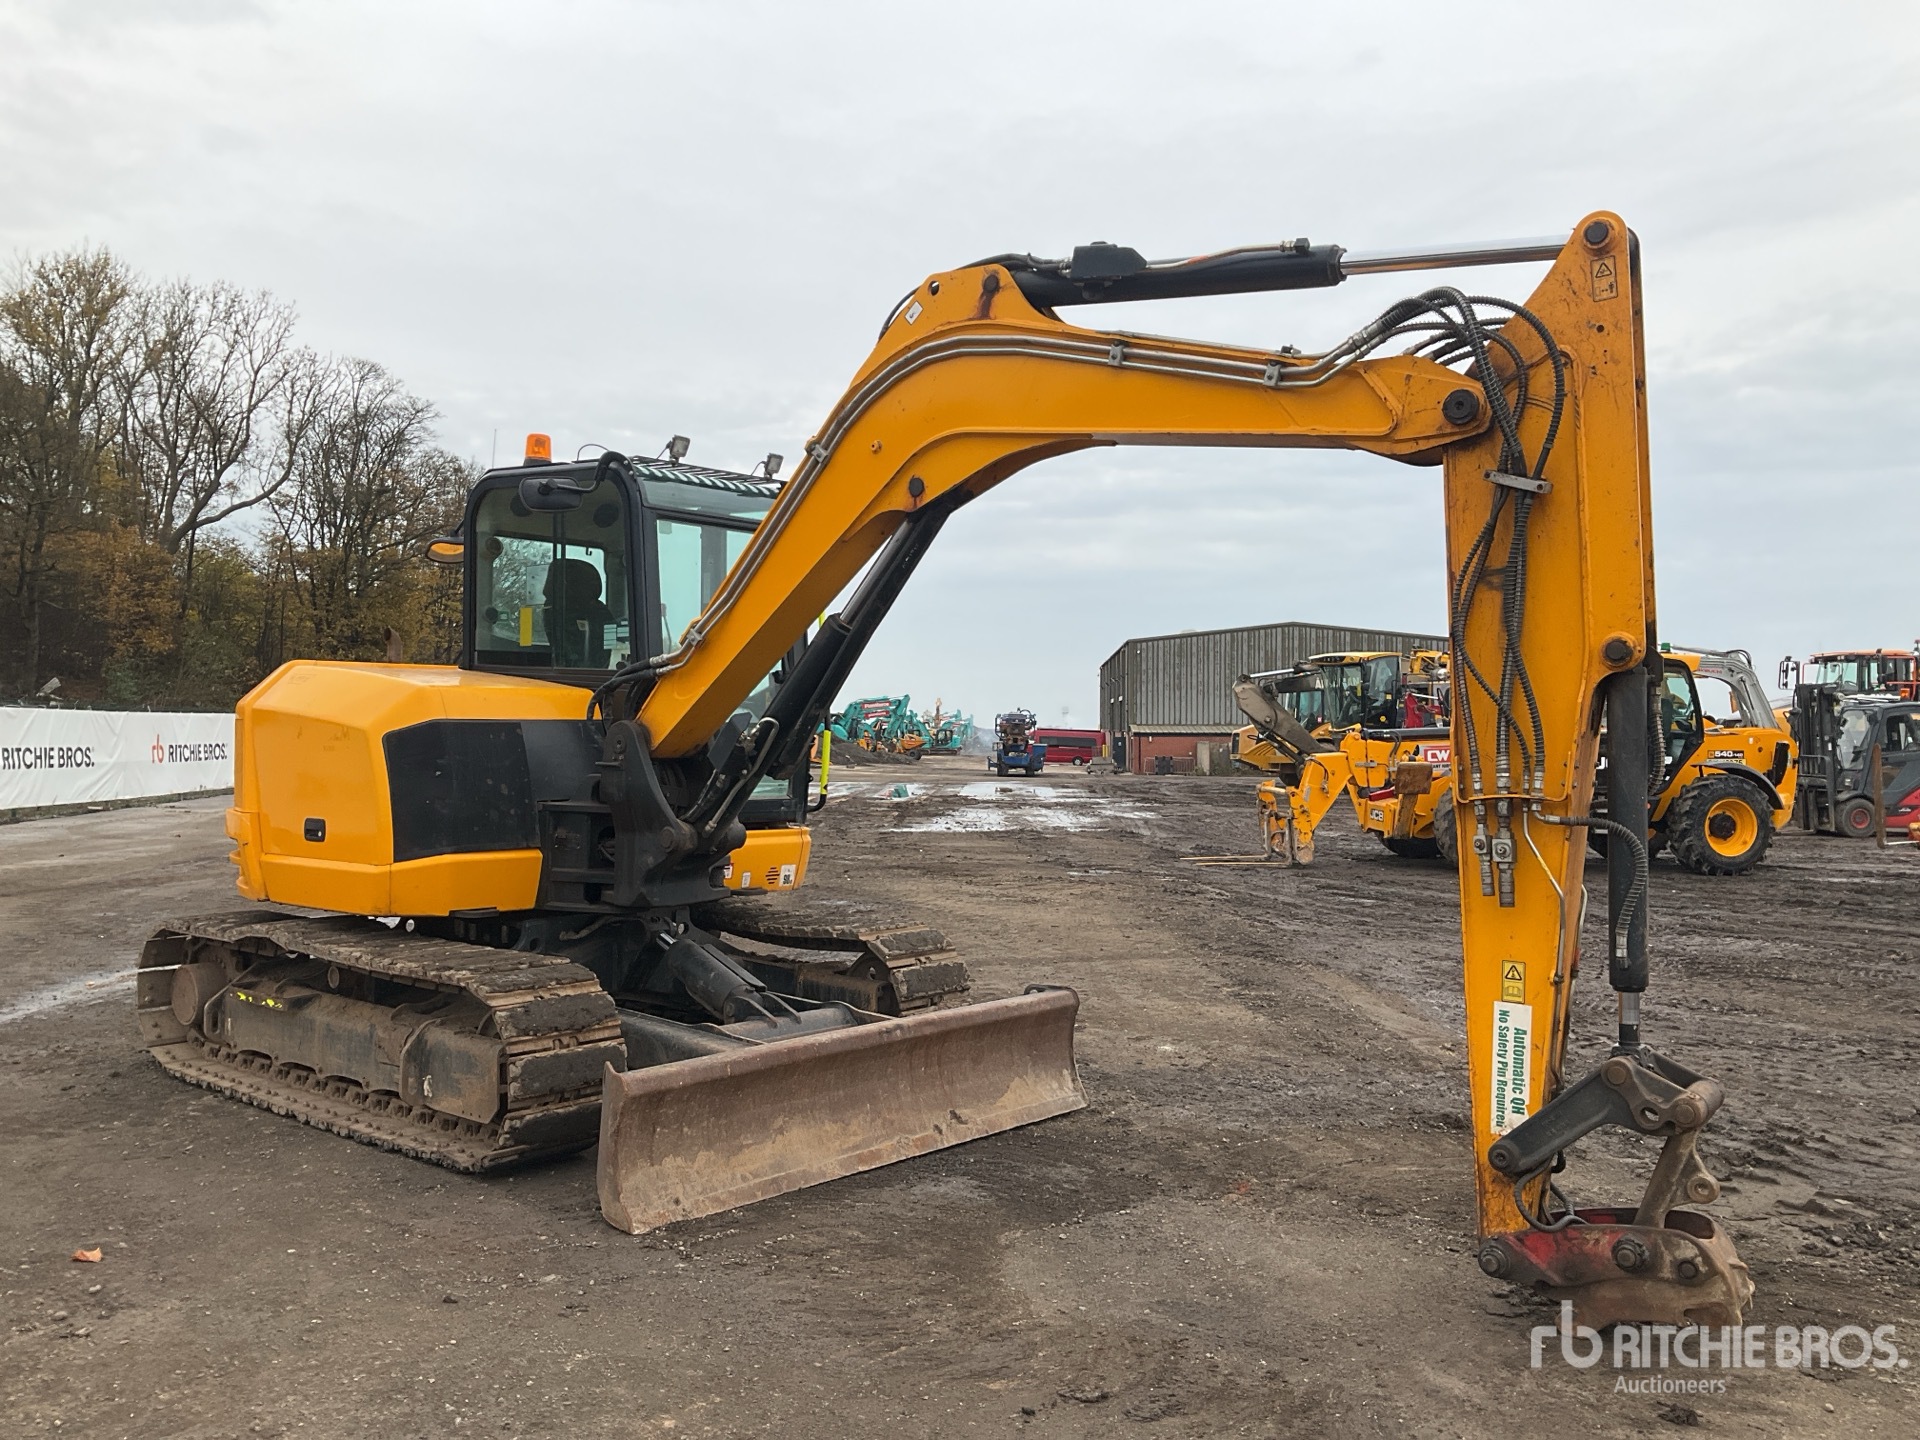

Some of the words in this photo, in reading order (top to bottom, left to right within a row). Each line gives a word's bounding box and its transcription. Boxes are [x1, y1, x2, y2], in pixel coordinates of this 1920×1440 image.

[1, 747, 55, 770] RITCHIE
[57, 746, 95, 768] BROS.
[168, 744, 202, 763] RITCHIE
[203, 742, 228, 761] BROS.
[1427, 750, 1450, 761] CW
[1370, 809, 1384, 821] JCB
[1498, 1009, 1510, 1023] No
[1497, 1025, 1510, 1059] Safety
[1497, 1060, 1508, 1077] Pin
[1512, 1027, 1528, 1095] Automatic
[1510, 1097, 1526, 1115] QH
